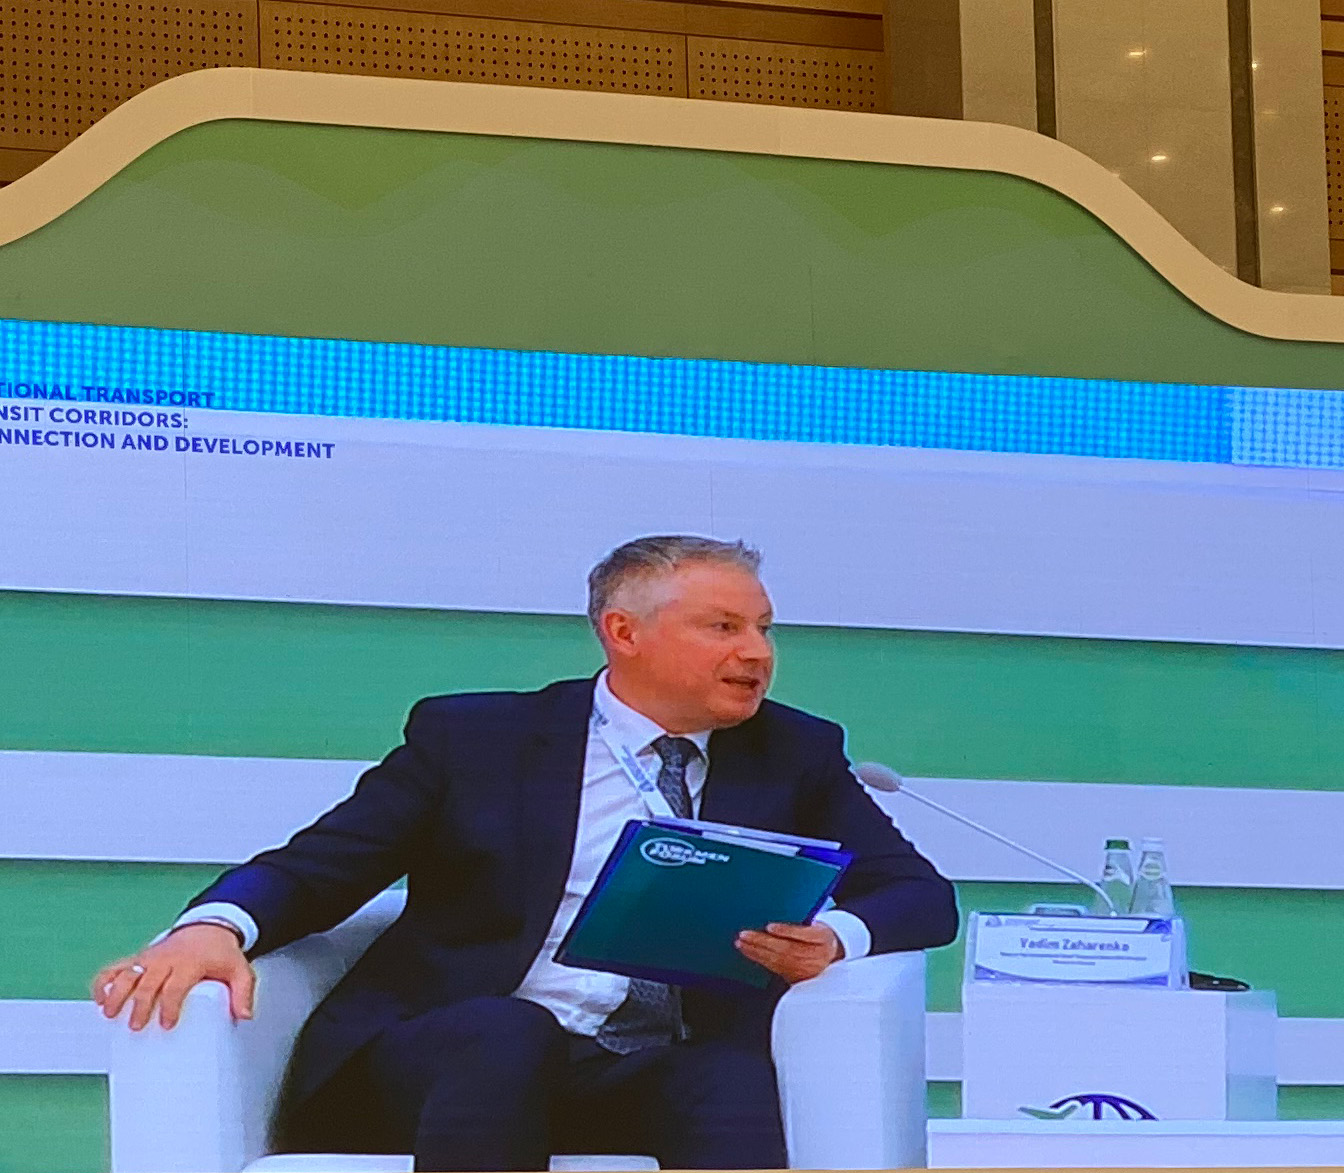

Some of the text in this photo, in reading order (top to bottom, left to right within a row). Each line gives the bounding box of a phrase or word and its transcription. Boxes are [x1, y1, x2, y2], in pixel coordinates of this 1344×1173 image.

[81, 385, 216, 408] TRANSPORT
[49, 407, 188, 429] CORRIDORS:
[121, 433, 169, 451] AND
[175, 436, 336, 459] DEVELOPMENT
